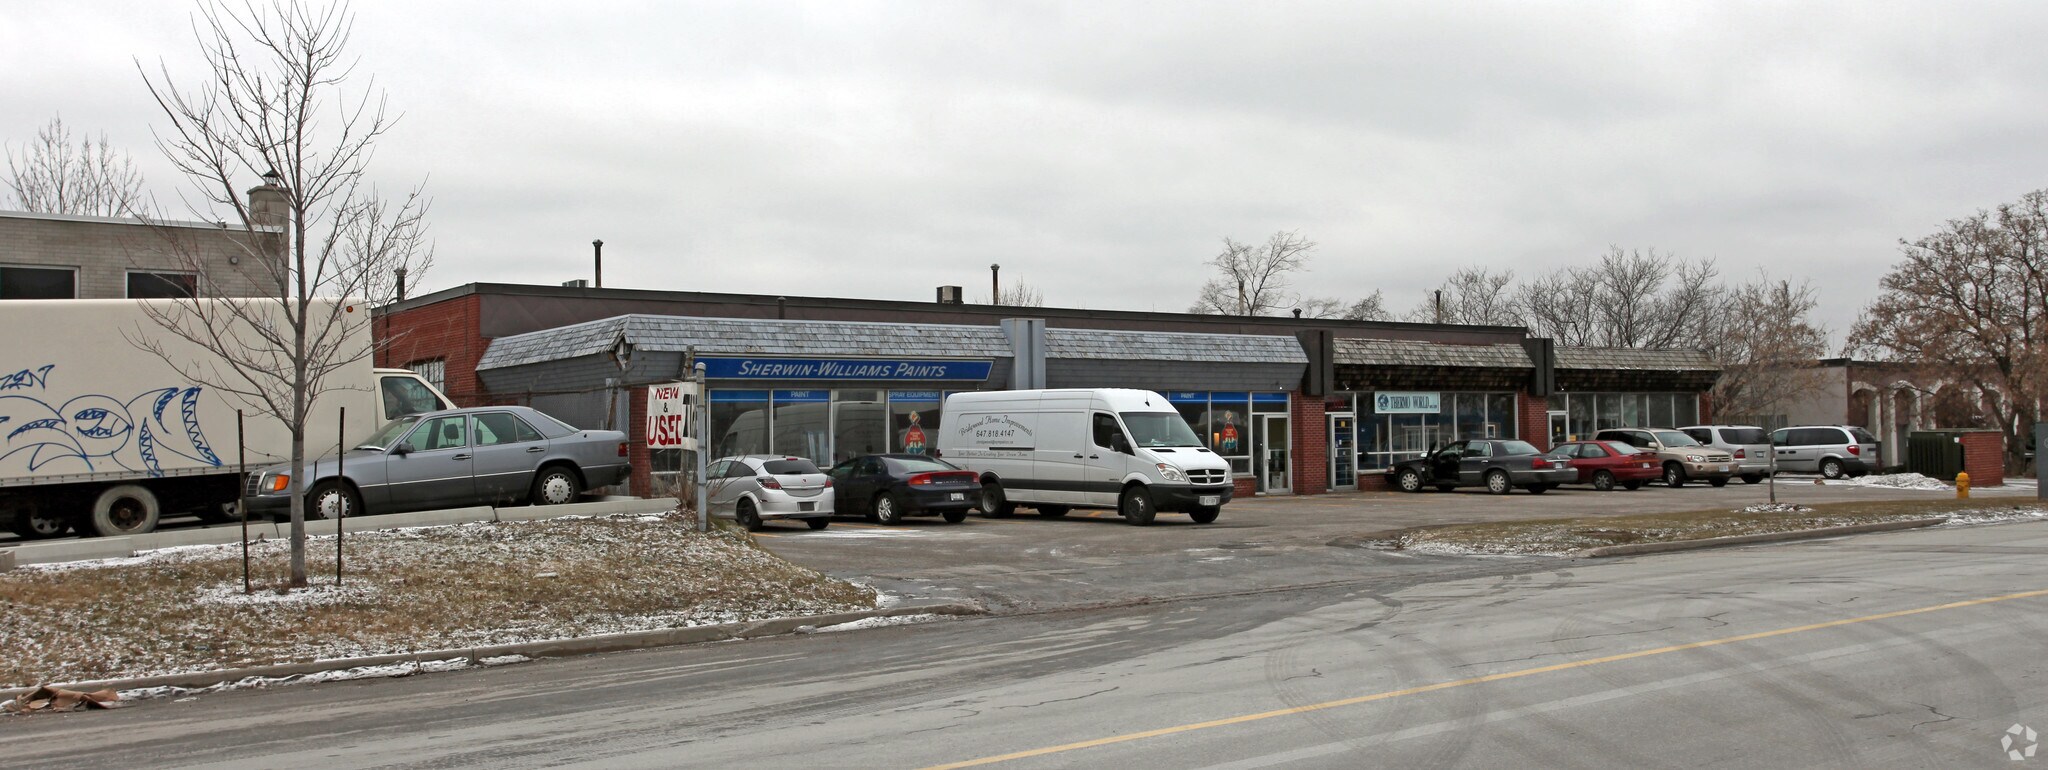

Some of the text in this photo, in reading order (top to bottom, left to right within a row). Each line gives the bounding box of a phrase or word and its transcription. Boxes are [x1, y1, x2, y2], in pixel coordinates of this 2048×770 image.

[738, 360, 947, 377] SHERWIN-WILLIAMS PAINTS
[654, 386, 680, 400] NEW
[790, 390, 810, 398] PAINT
[663, 402, 668, 413] &
[1390, 395, 1430, 409] THERMO WORLD
[975, 429, 1015, 438] 647.818.4147
